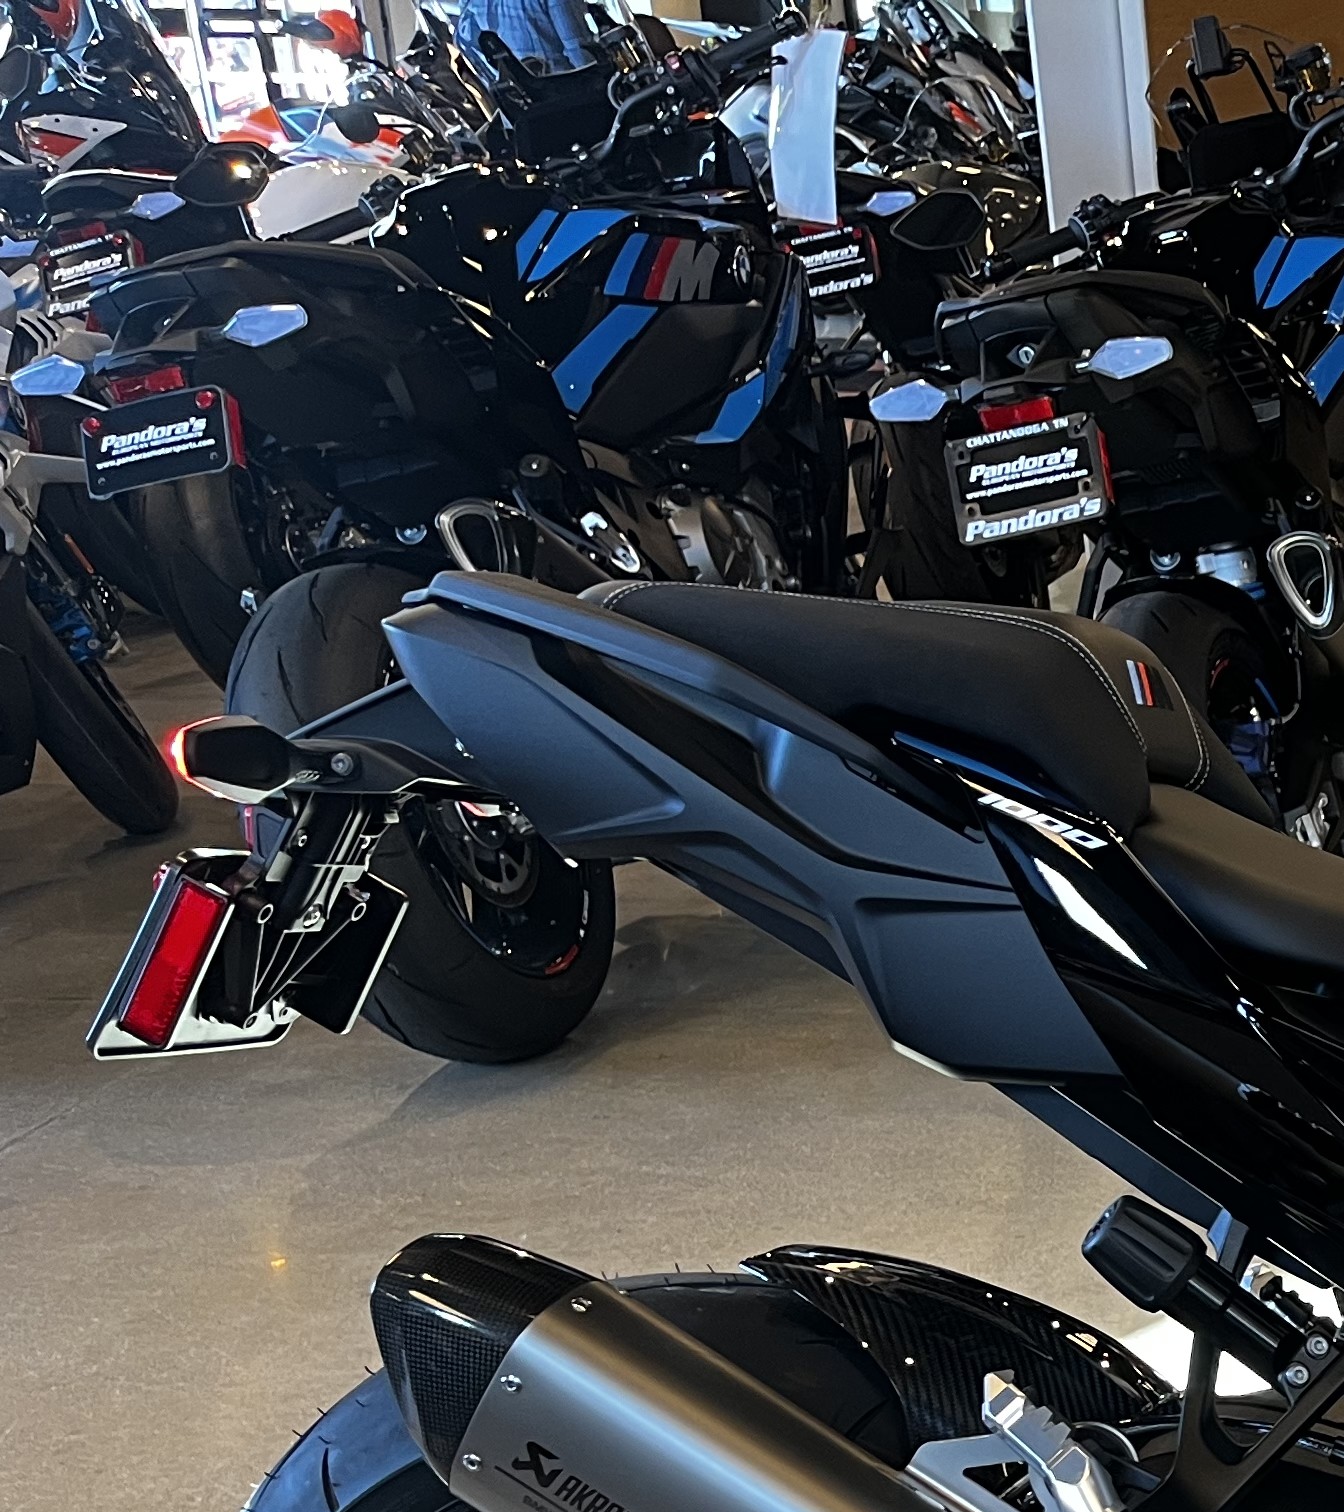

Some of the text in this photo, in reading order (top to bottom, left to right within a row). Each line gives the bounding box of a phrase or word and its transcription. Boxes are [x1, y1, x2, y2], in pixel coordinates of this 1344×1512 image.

[101, 417, 206, 453] Pandora's
[966, 417, 1069, 448] CHATTANOOGA TN
[969, 447, 1078, 482] Pandora's
[965, 497, 1101, 542] Pandora's
